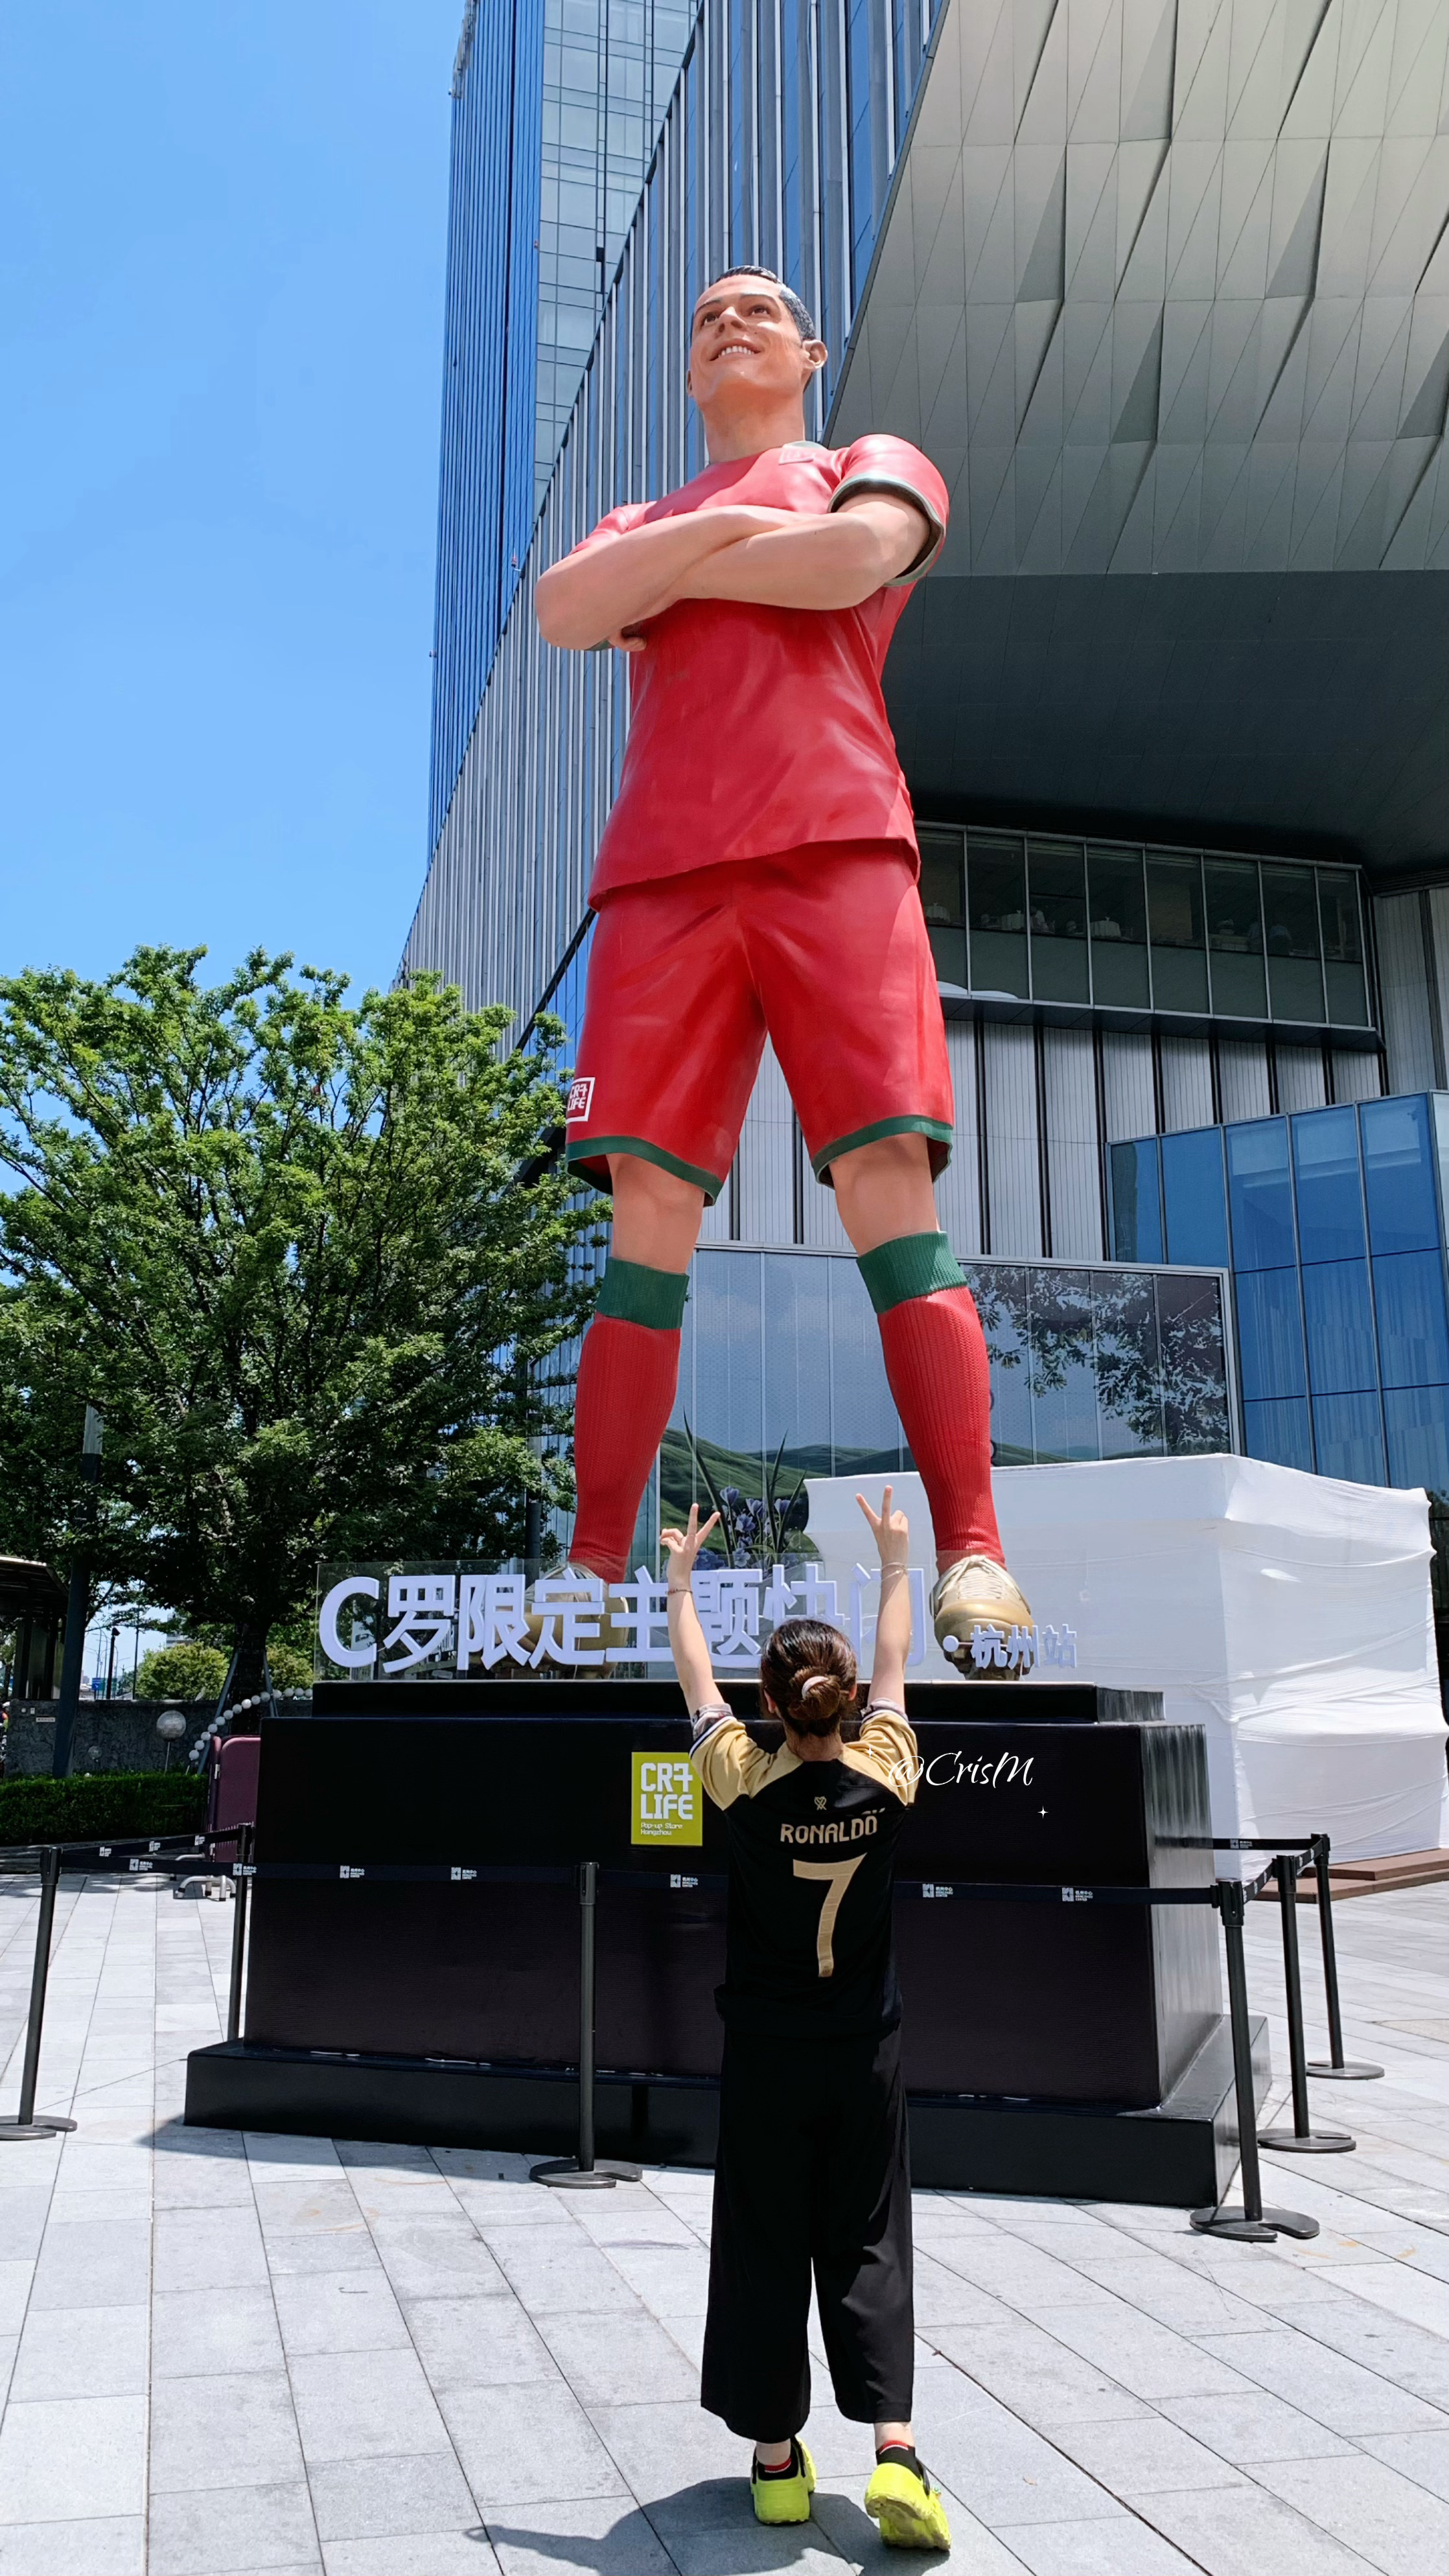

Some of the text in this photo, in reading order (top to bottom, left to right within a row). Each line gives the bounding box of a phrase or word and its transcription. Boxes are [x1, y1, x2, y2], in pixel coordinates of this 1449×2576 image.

[641, 1763, 693, 1793] CR7
[640, 1794, 693, 1820] LIFE
[780, 1815, 877, 1844] RONALDO
[793, 1852, 868, 1977] 7
